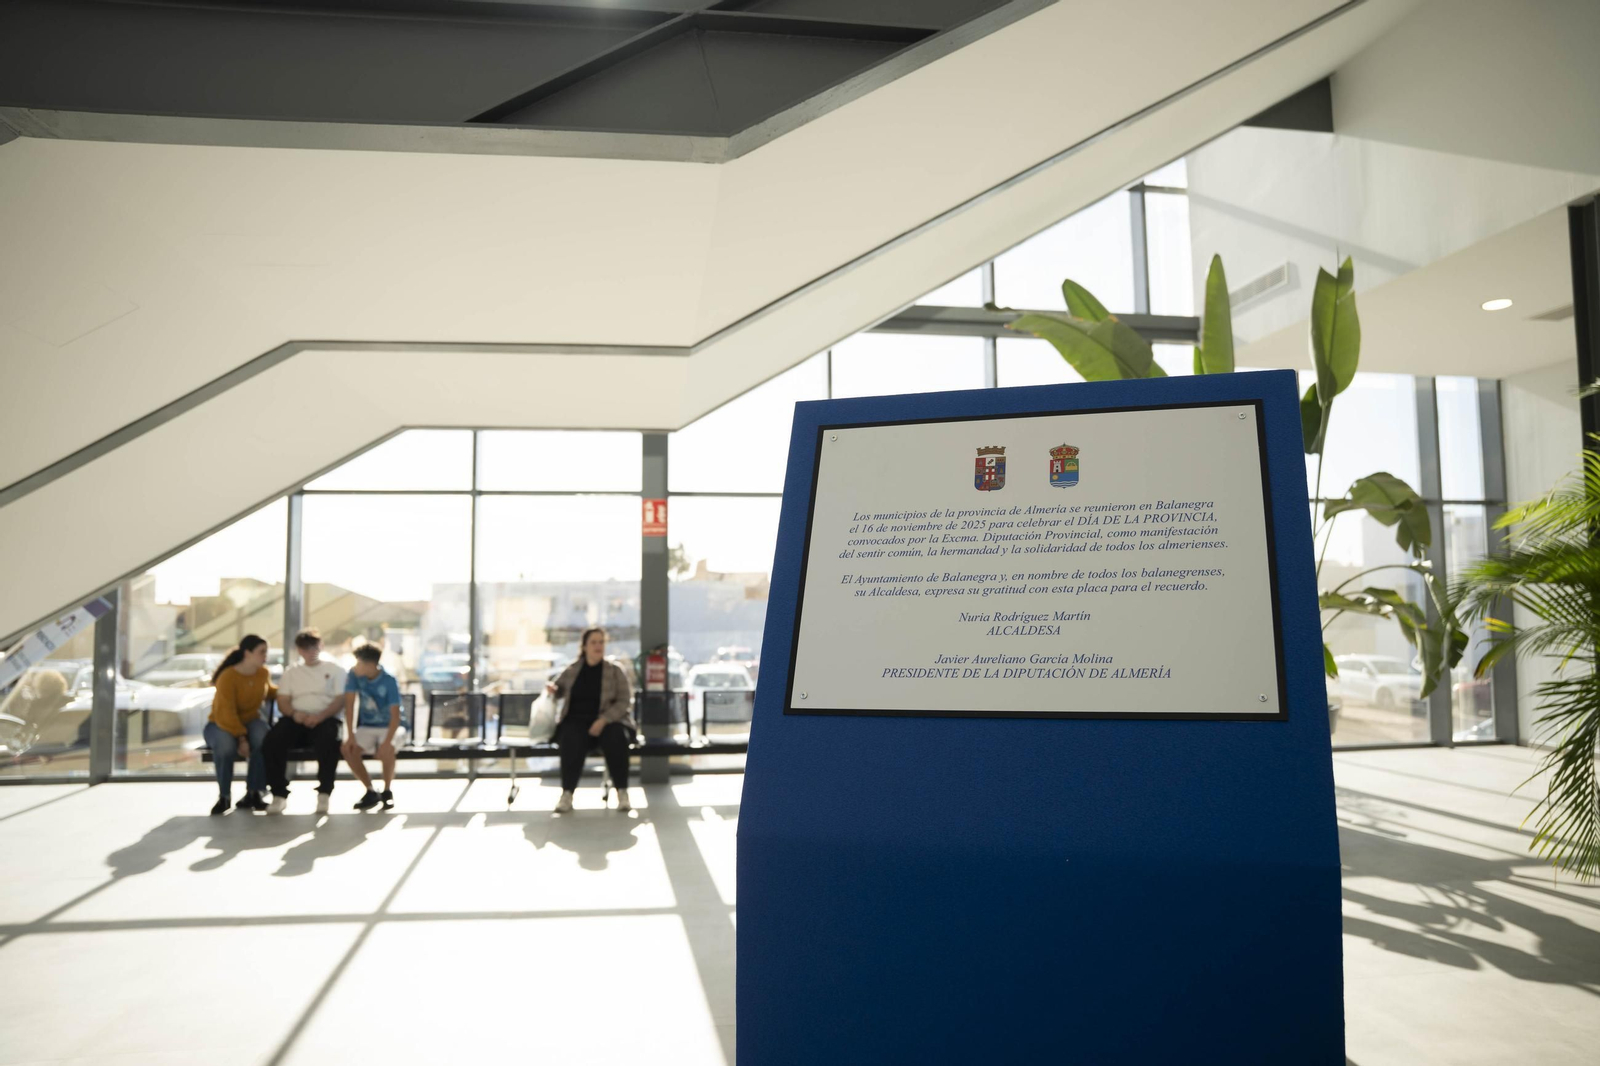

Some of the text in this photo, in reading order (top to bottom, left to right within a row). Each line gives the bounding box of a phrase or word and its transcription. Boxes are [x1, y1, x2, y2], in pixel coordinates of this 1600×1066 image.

[852, 499, 1214, 522] Los municipios de la provincia de Almería se reunieron en Balanegra
[848, 511, 1217, 534] el 16 de noviembre de 2025 para celebrar el DÍA DE LA PROVINCIA,
[847, 524, 1218, 547] convocados por la Excma. Diputación Provincial, como manifestación
[838, 539, 1228, 559] del sentir común, la hermandad y la solidaridad de todos los almerienses.
[840, 567, 1225, 586] El Ayuntamiento de Balanegra y, en nombre de todos los balanegrenses,
[853, 580, 1208, 598] su Alcaldesa, expresa su gratitud con esta placa para el recuerdo.
[958, 610, 1091, 625] Nuria Rodríguez Martín
[986, 624, 1061, 636] ALCALDESA
[933, 653, 1113, 665] Javier Aureliano García Molina
[881, 664, 1171, 679] PRESIDENTE DE LA DIPUTACIÓN DE ALMERÍA
